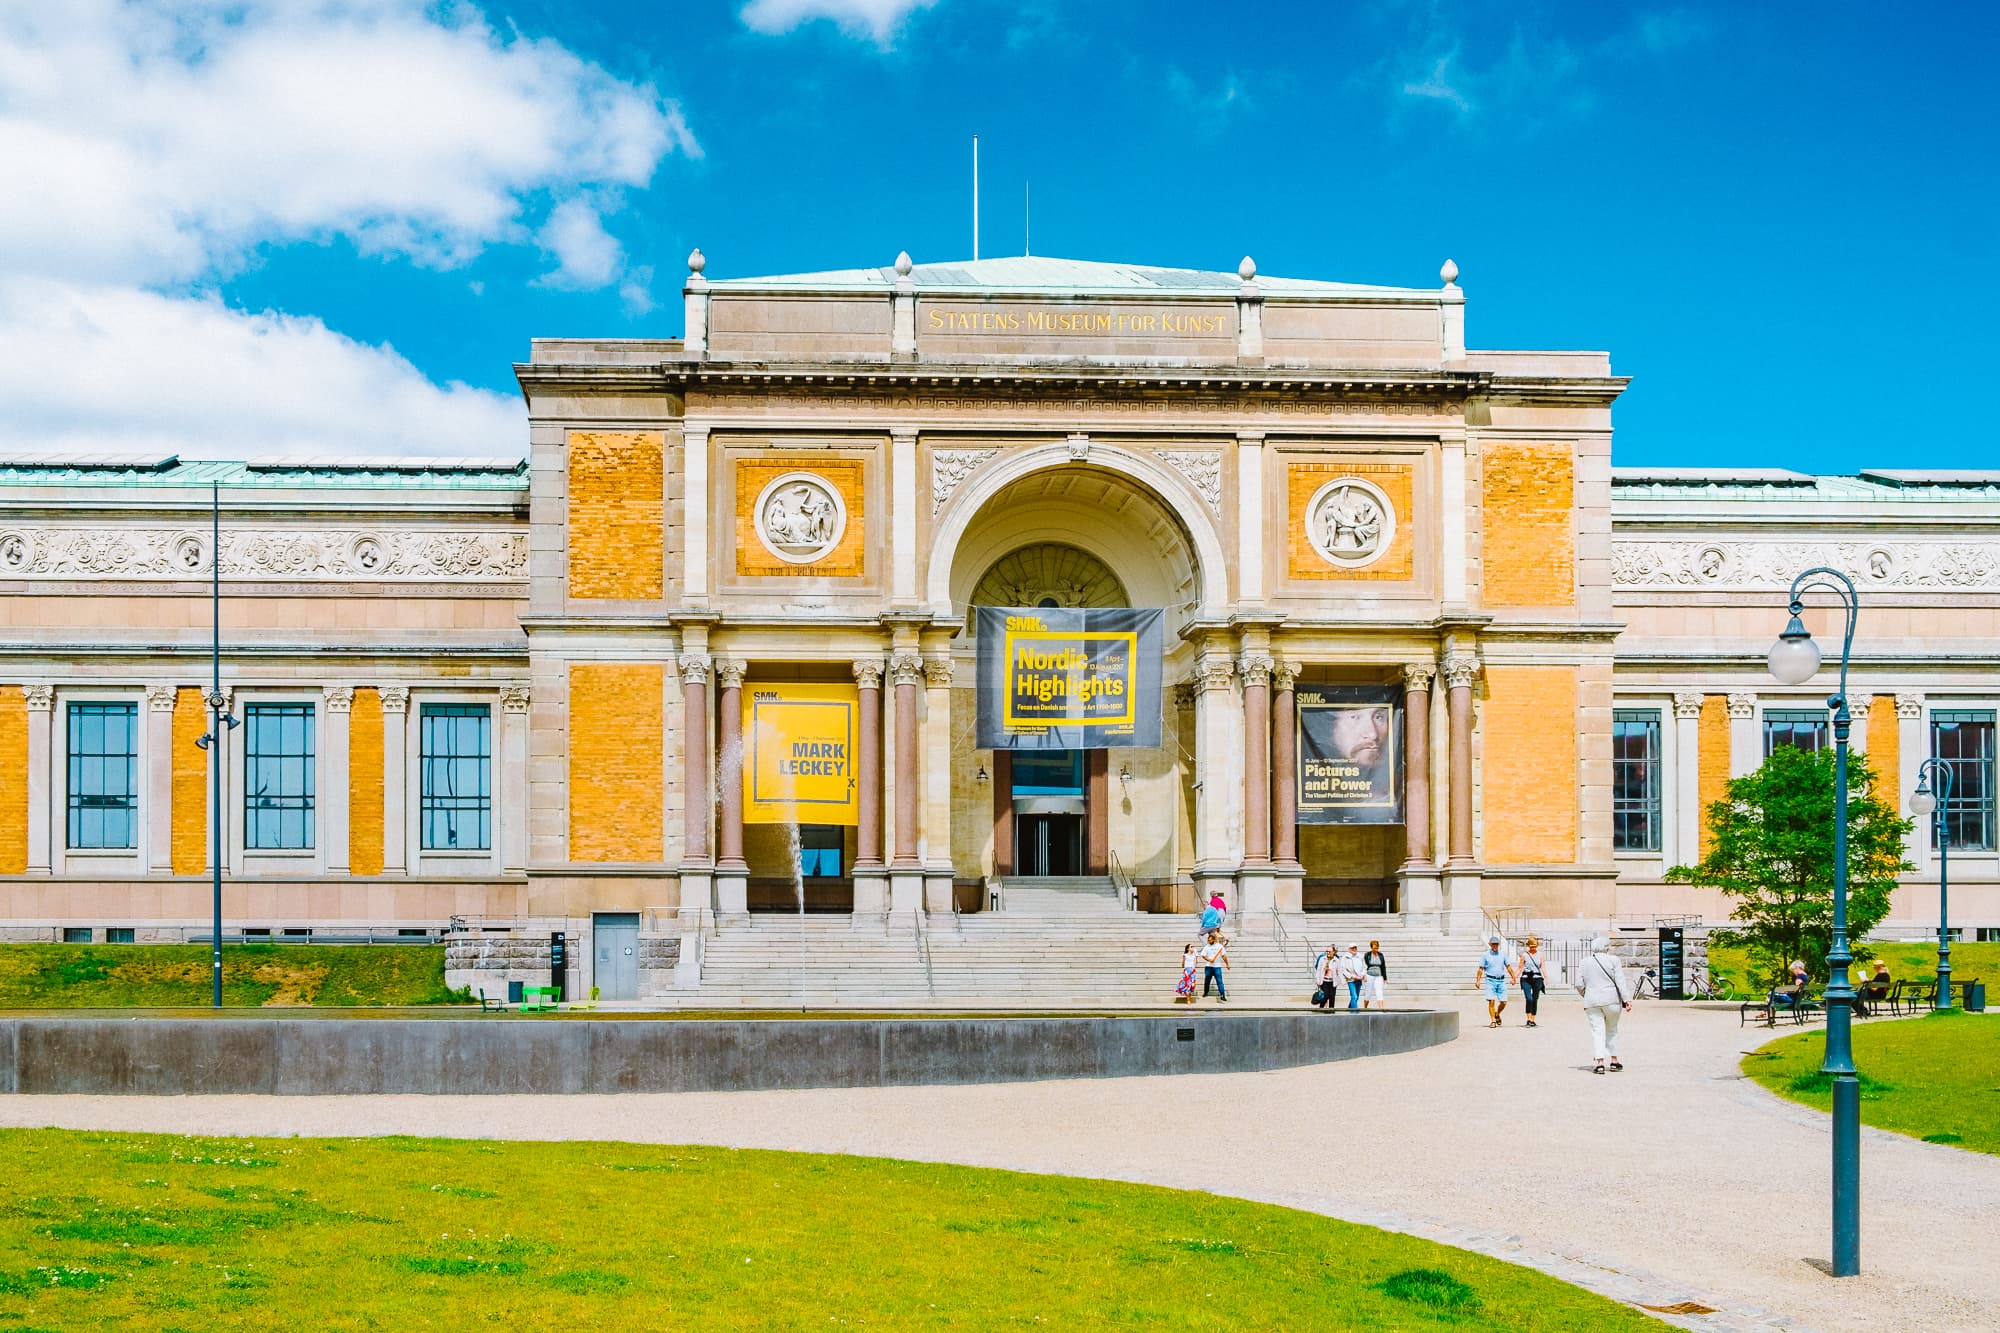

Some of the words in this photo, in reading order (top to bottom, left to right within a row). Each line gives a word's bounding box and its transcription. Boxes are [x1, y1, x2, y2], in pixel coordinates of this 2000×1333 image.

[929, 308, 1019, 329] STATENS
[1027, 311, 1111, 331] MUSEUM
[1118, 313, 1155, 331] FOR
[1162, 312, 1226, 332] KUNST
[1018, 648, 1089, 670] Nordic
[1017, 674, 1124, 702] Highlights
[792, 742, 845, 759] MARK
[780, 760, 845, 776] LECKEY
[1305, 764, 1360, 777] Pictures
[1305, 778, 1329, 791] and
[1331, 778, 1373, 791] Power
